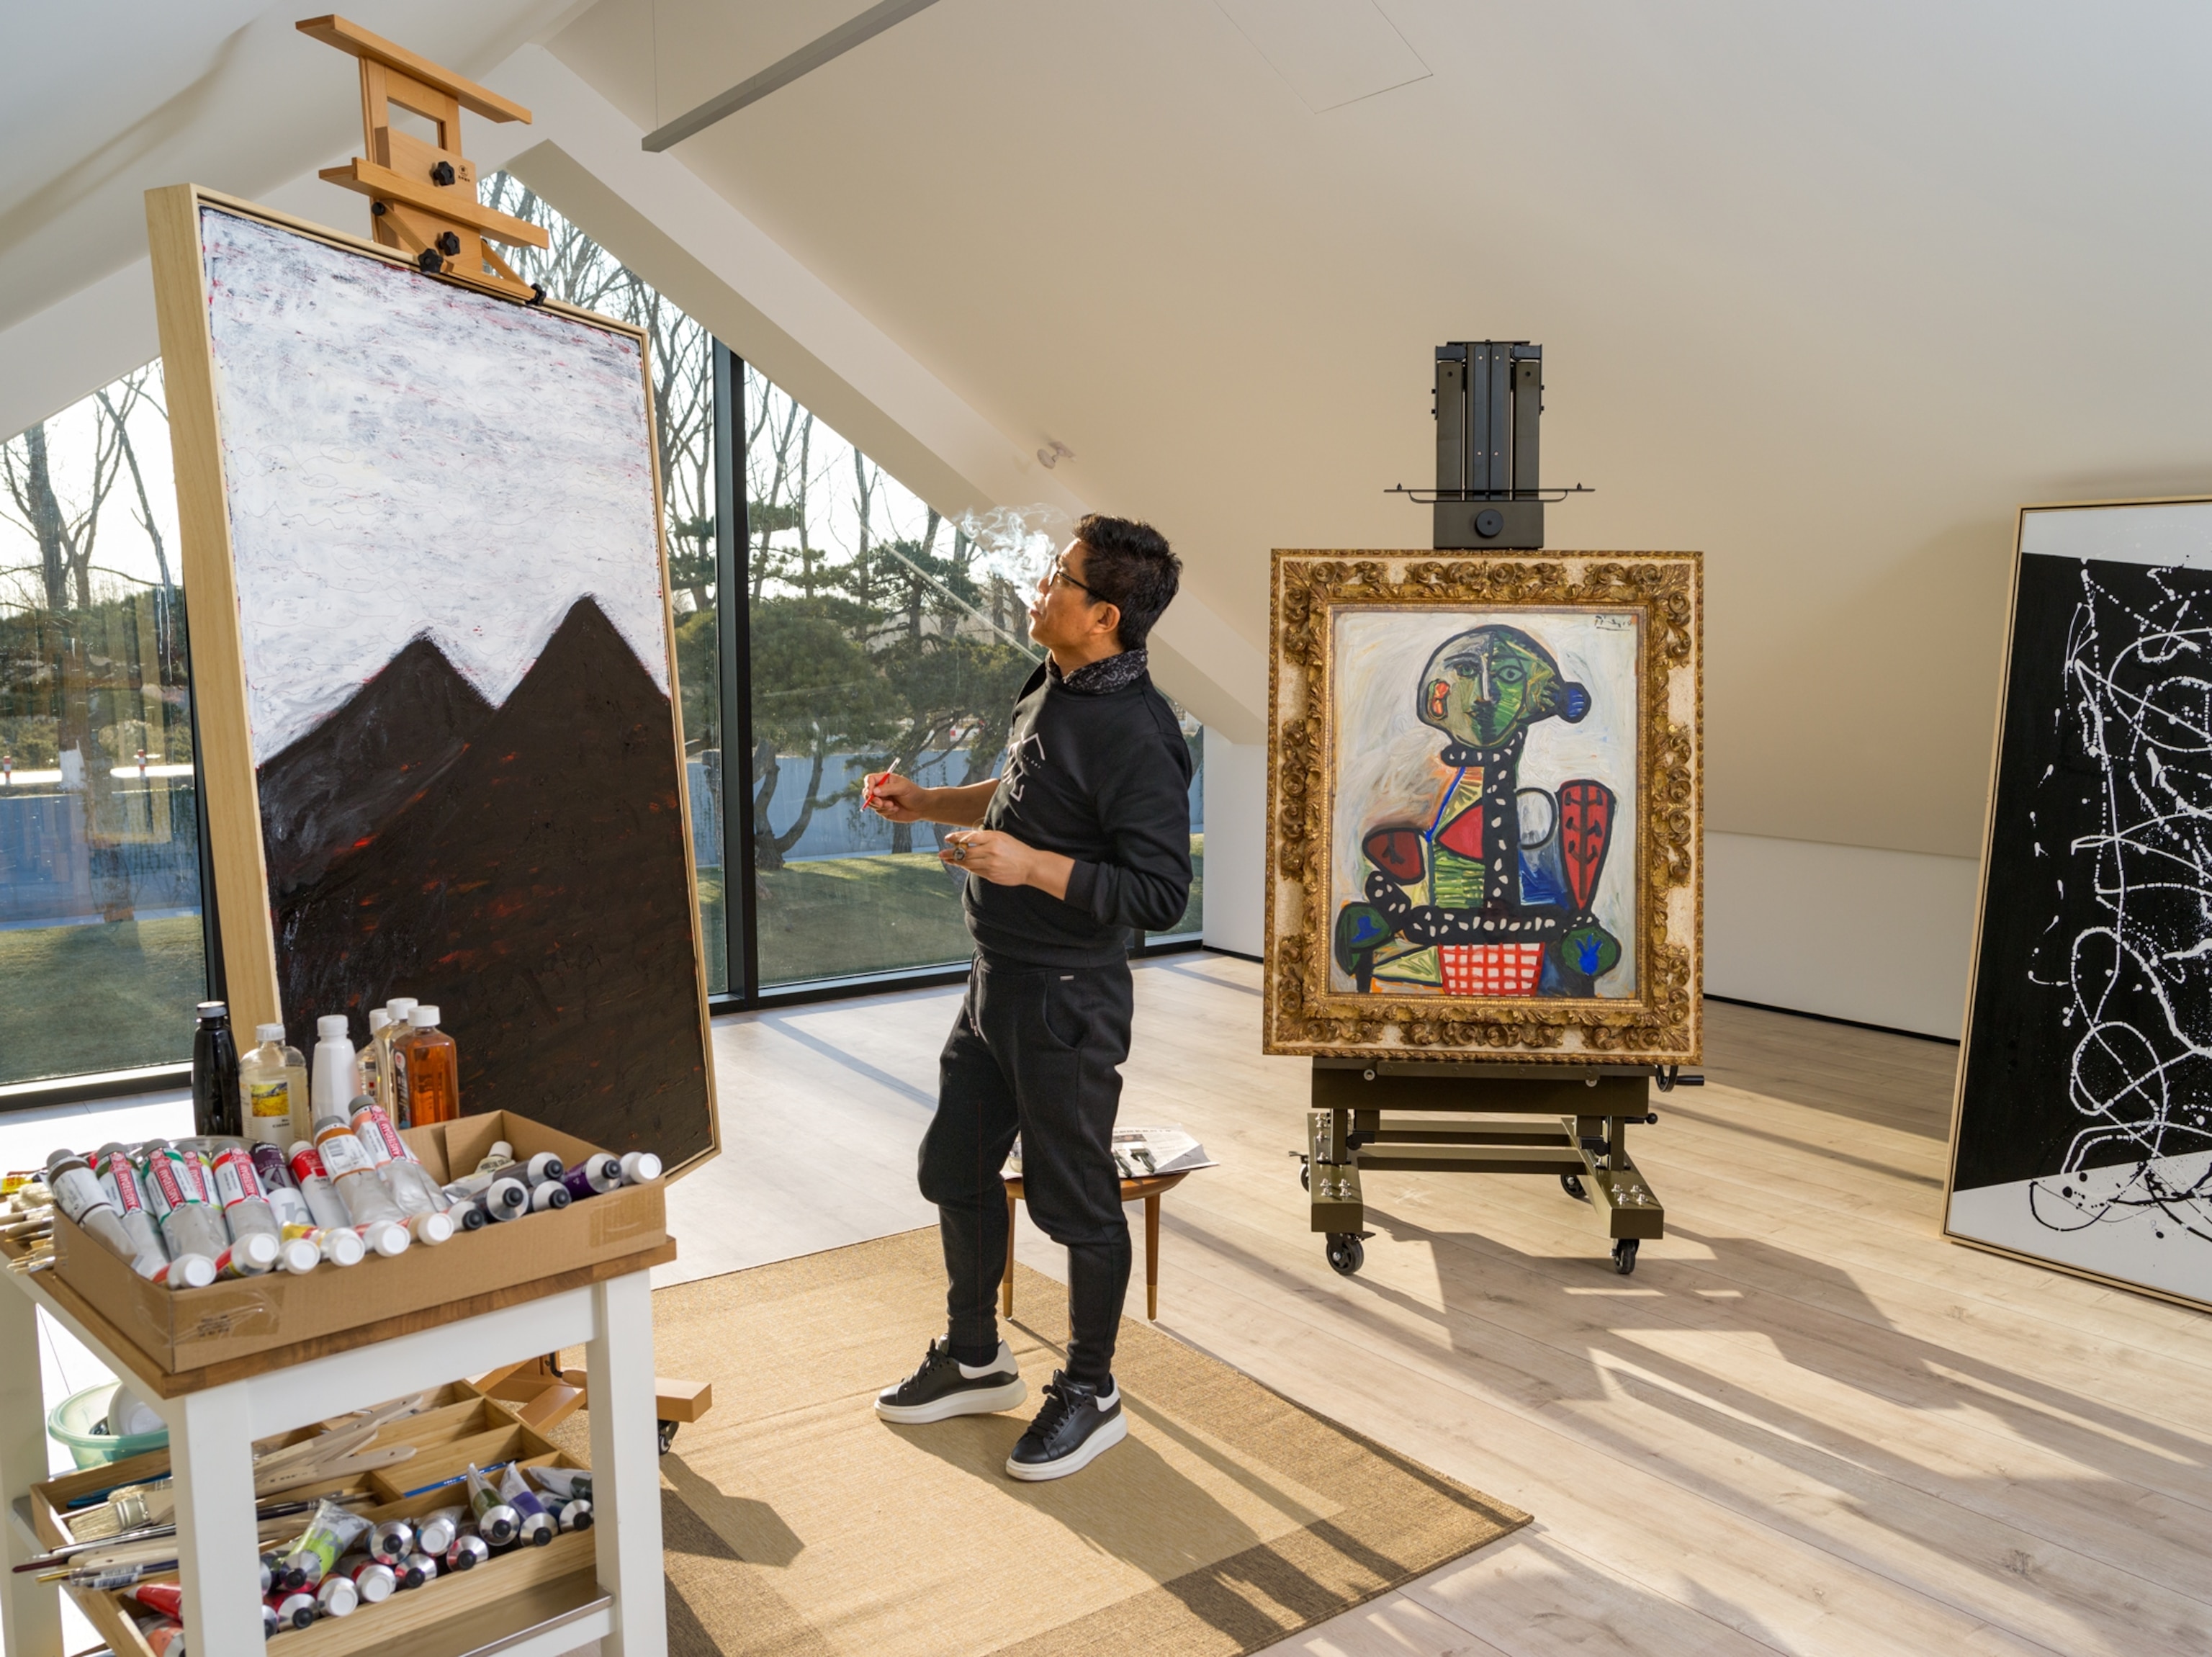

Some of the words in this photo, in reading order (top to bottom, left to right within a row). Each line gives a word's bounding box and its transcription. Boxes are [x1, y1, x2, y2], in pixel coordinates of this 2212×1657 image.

[382, 1123, 400, 1155] AMSTERDAM
[120, 1172, 137, 1208] AMSTERDAM
[159, 1169, 180, 1202] AMSTERDAM
[239, 1165, 255, 1193] AMSTERDAM
